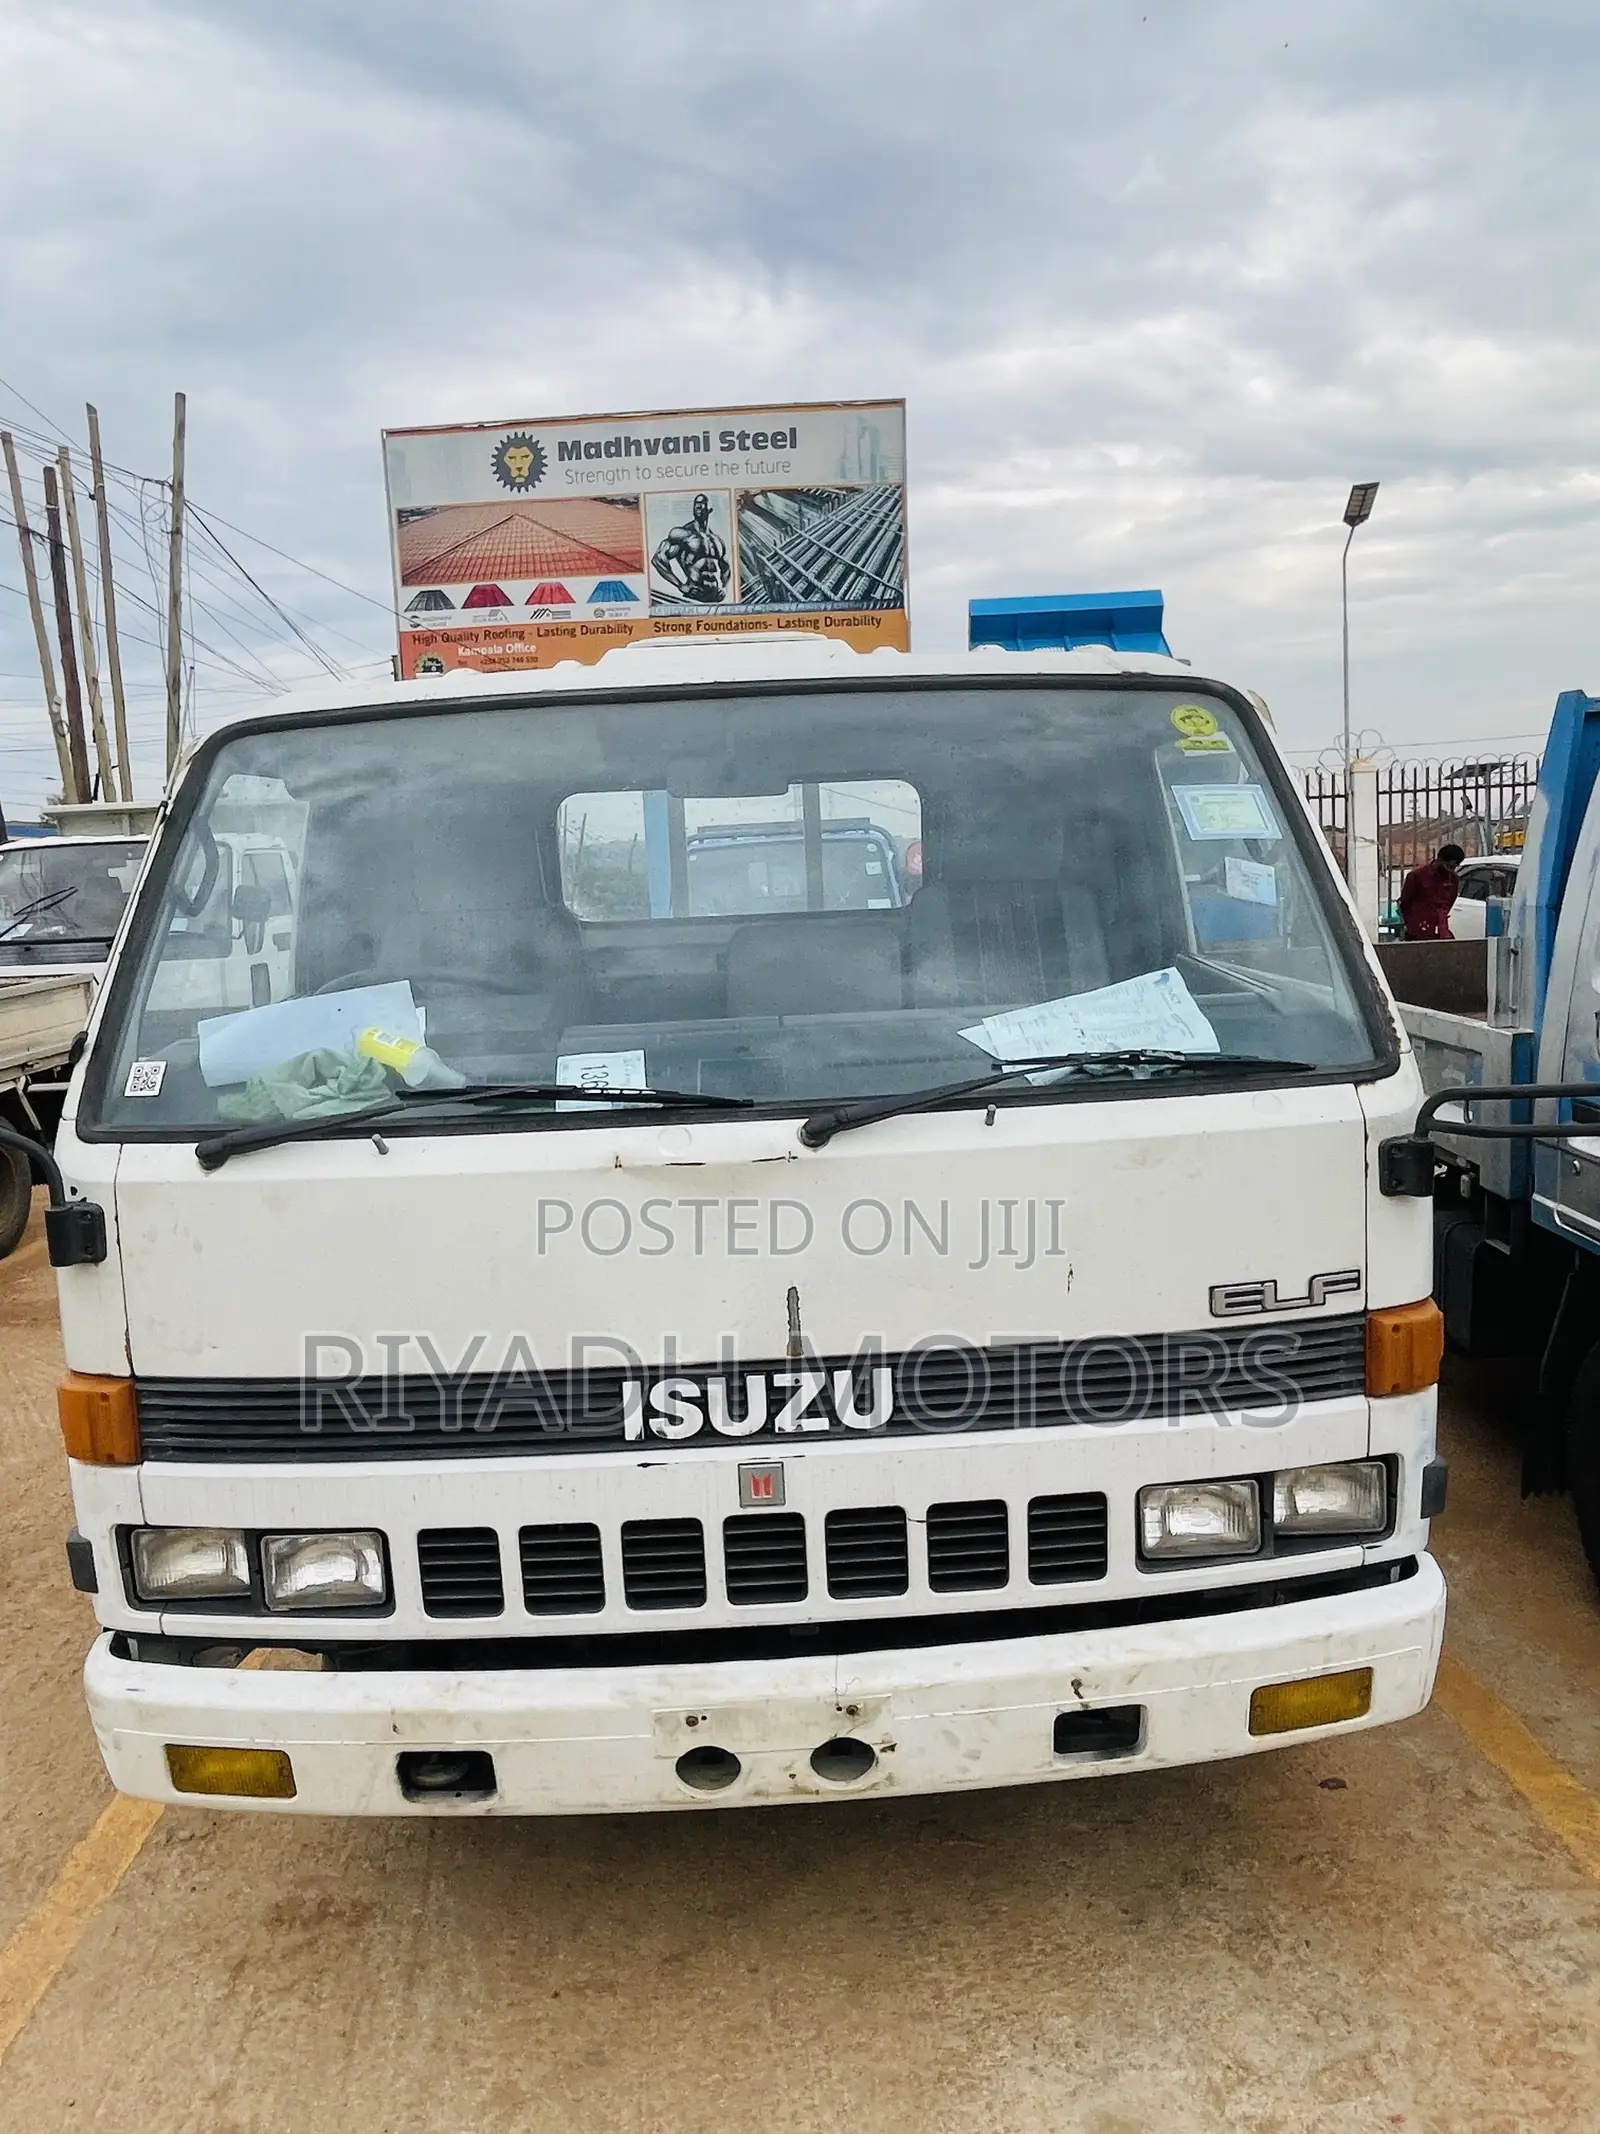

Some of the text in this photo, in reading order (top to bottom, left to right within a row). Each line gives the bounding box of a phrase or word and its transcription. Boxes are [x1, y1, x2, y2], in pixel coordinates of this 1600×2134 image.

[557, 427, 797, 462] Madhvani Steel
[564, 457, 791, 486] Strength to secure the future
[411, 633, 438, 647] High
[441, 631, 480, 644] Quality
[483, 628, 526, 642] Roofing
[536, 626, 577, 639] Lasting
[580, 621, 634, 636] Durability
[653, 620, 692, 634] Strong
[777, 617, 820, 631] Lasting
[824, 614, 882, 629] Durability
[505, 642, 537, 654] Office
[1208, 1268, 1362, 1318] ELF
[620, 1366, 895, 1442] ISUZU
